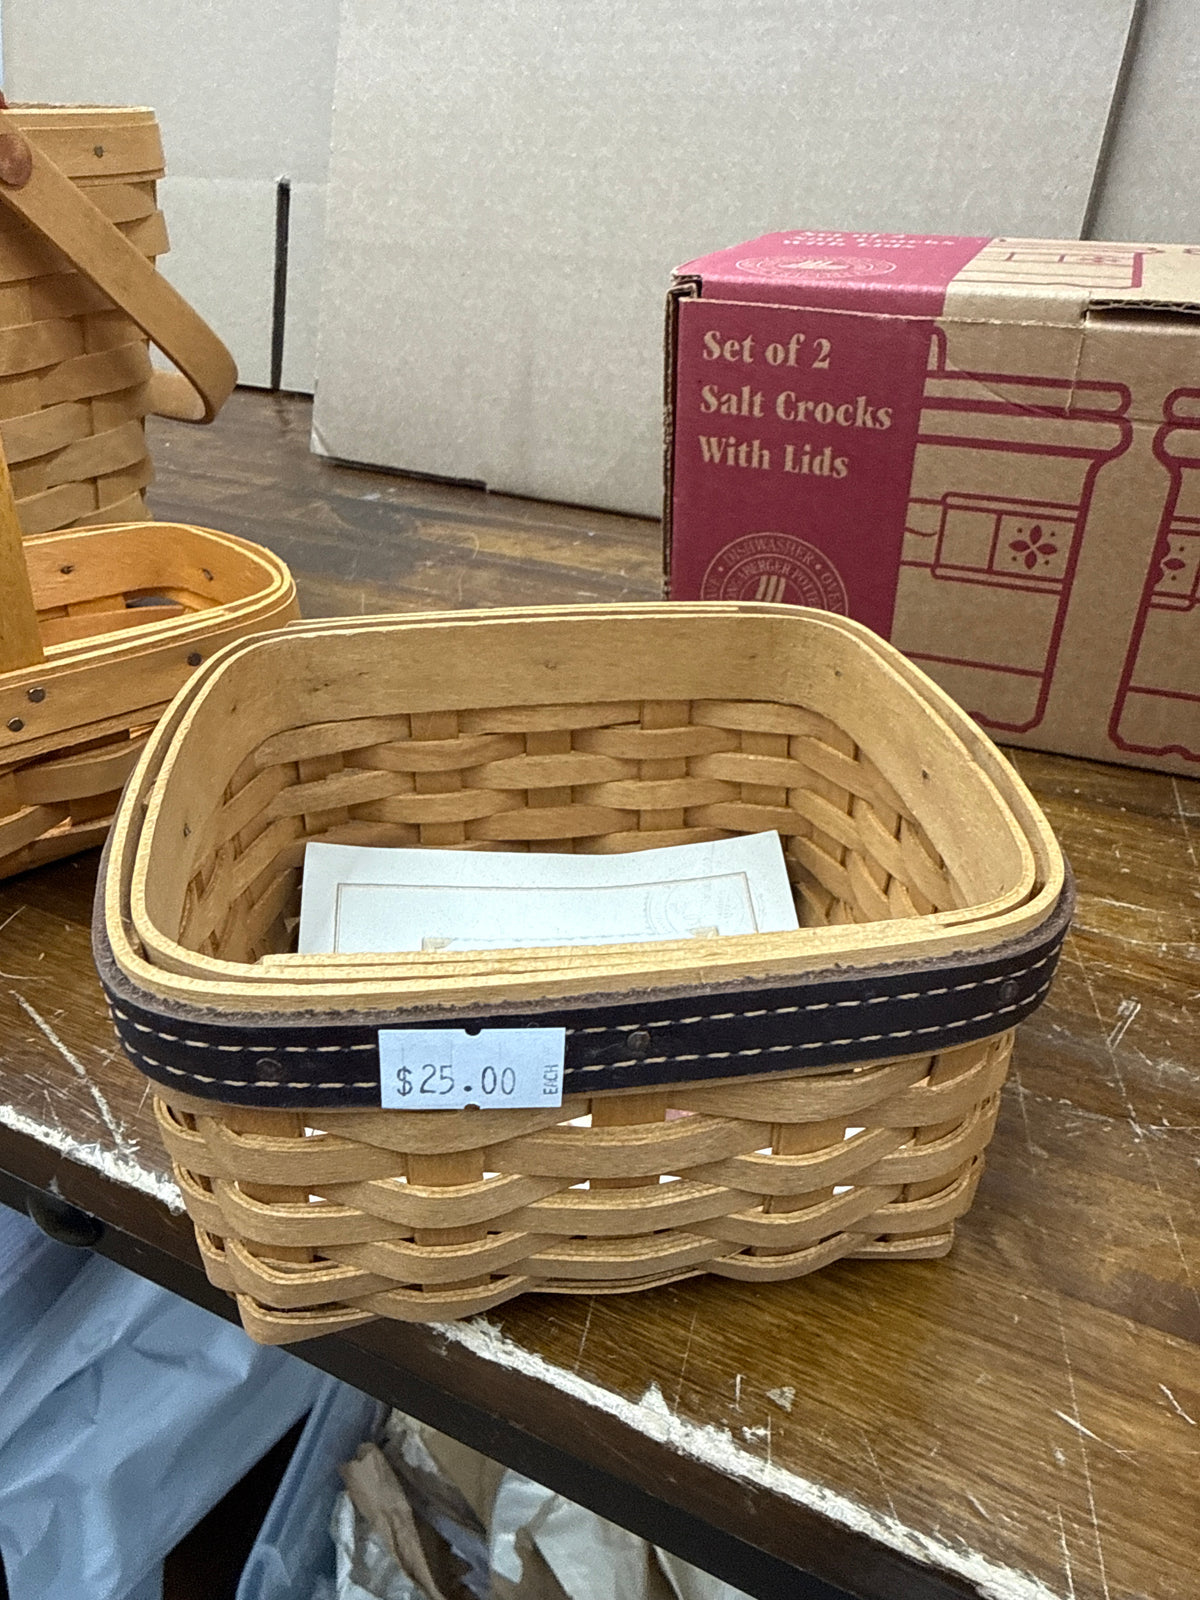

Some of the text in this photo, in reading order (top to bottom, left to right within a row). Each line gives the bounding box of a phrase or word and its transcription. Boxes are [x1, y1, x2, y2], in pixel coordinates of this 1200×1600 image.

[703, 330, 831, 369] Set of 2
[700, 384, 893, 430] Salt Crocks
[698, 435, 849, 479] With Lids
[722, 537, 815, 567] DISHWASHER
[396, 1063, 559, 1096] $25.00 EACH
